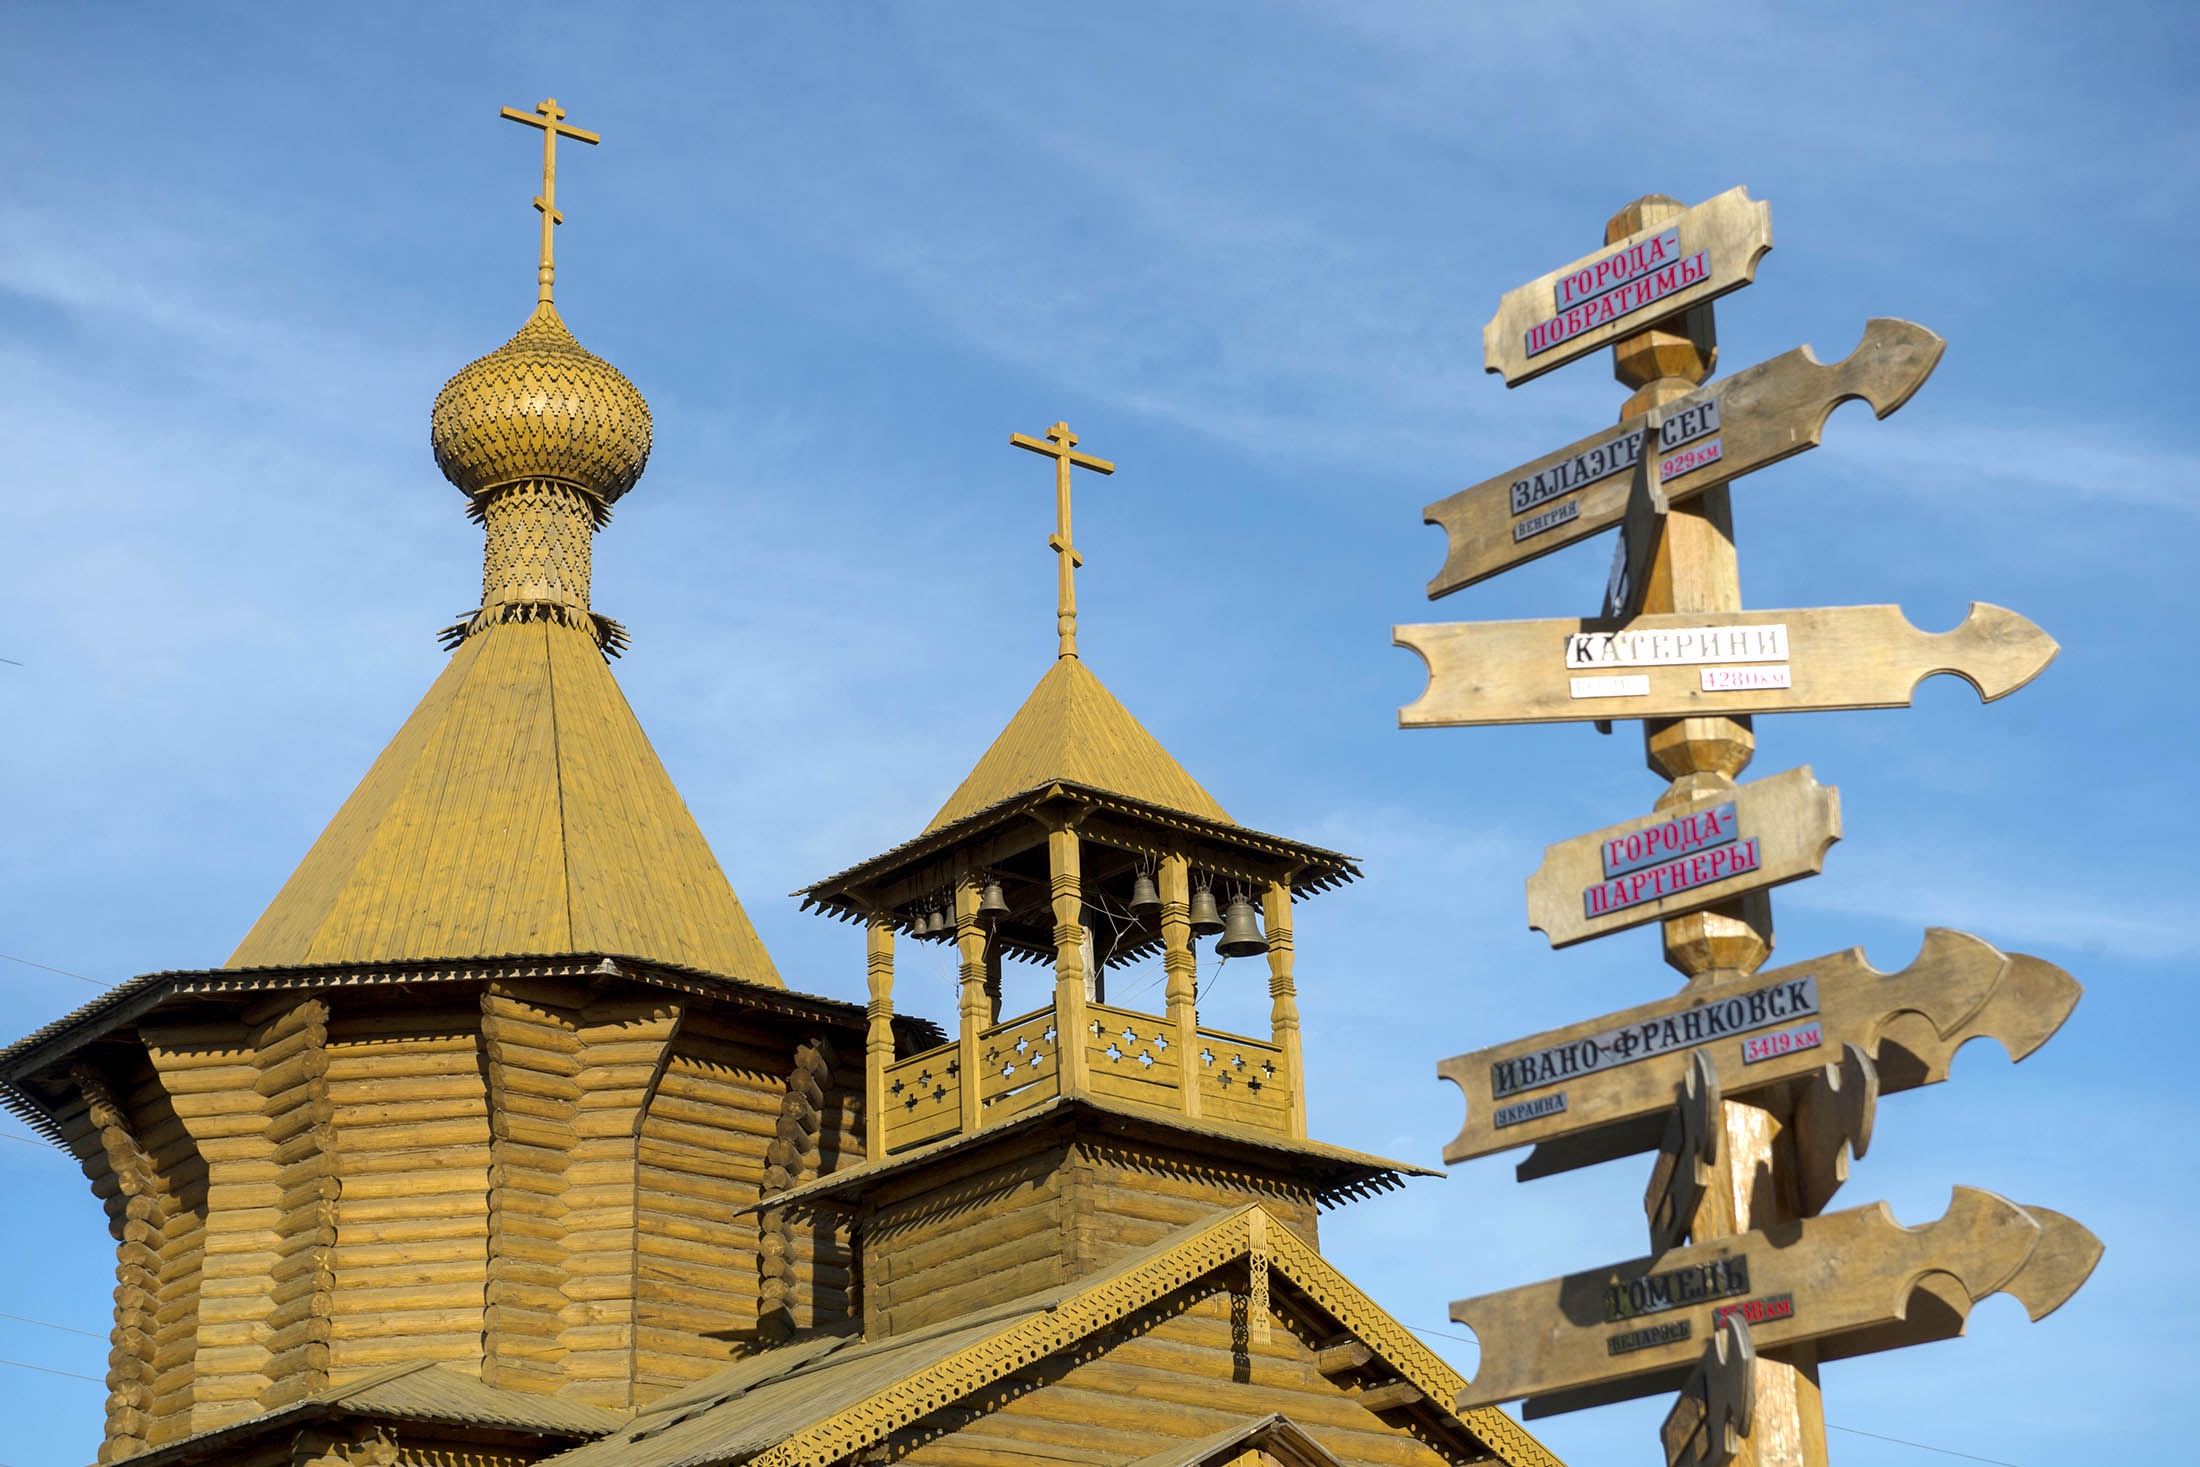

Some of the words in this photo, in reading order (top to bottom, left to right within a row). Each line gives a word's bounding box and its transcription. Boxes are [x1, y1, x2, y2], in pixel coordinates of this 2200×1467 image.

[1563, 234, 1676, 303] ГОРОДА-
[1530, 252, 1706, 352] ПОБРАТИМЫ
[1514, 402, 1714, 507] ЗАЛАЭГЕСЕГ
[1518, 501, 1577, 535] ВЕНГРИЯ
[1576, 631, 1778, 663] КАТЕРИНИ
[1608, 810, 1733, 868] ГОРОДА-
[1590, 840, 1757, 914] ПАРТНЕРЫ
[1493, 982, 1812, 1094] ИВАНО-ФРАНКОВСК
[1498, 1094, 1566, 1125] УКРАИНА
[1608, 1261, 1742, 1317] ГОМЕЛЬ
